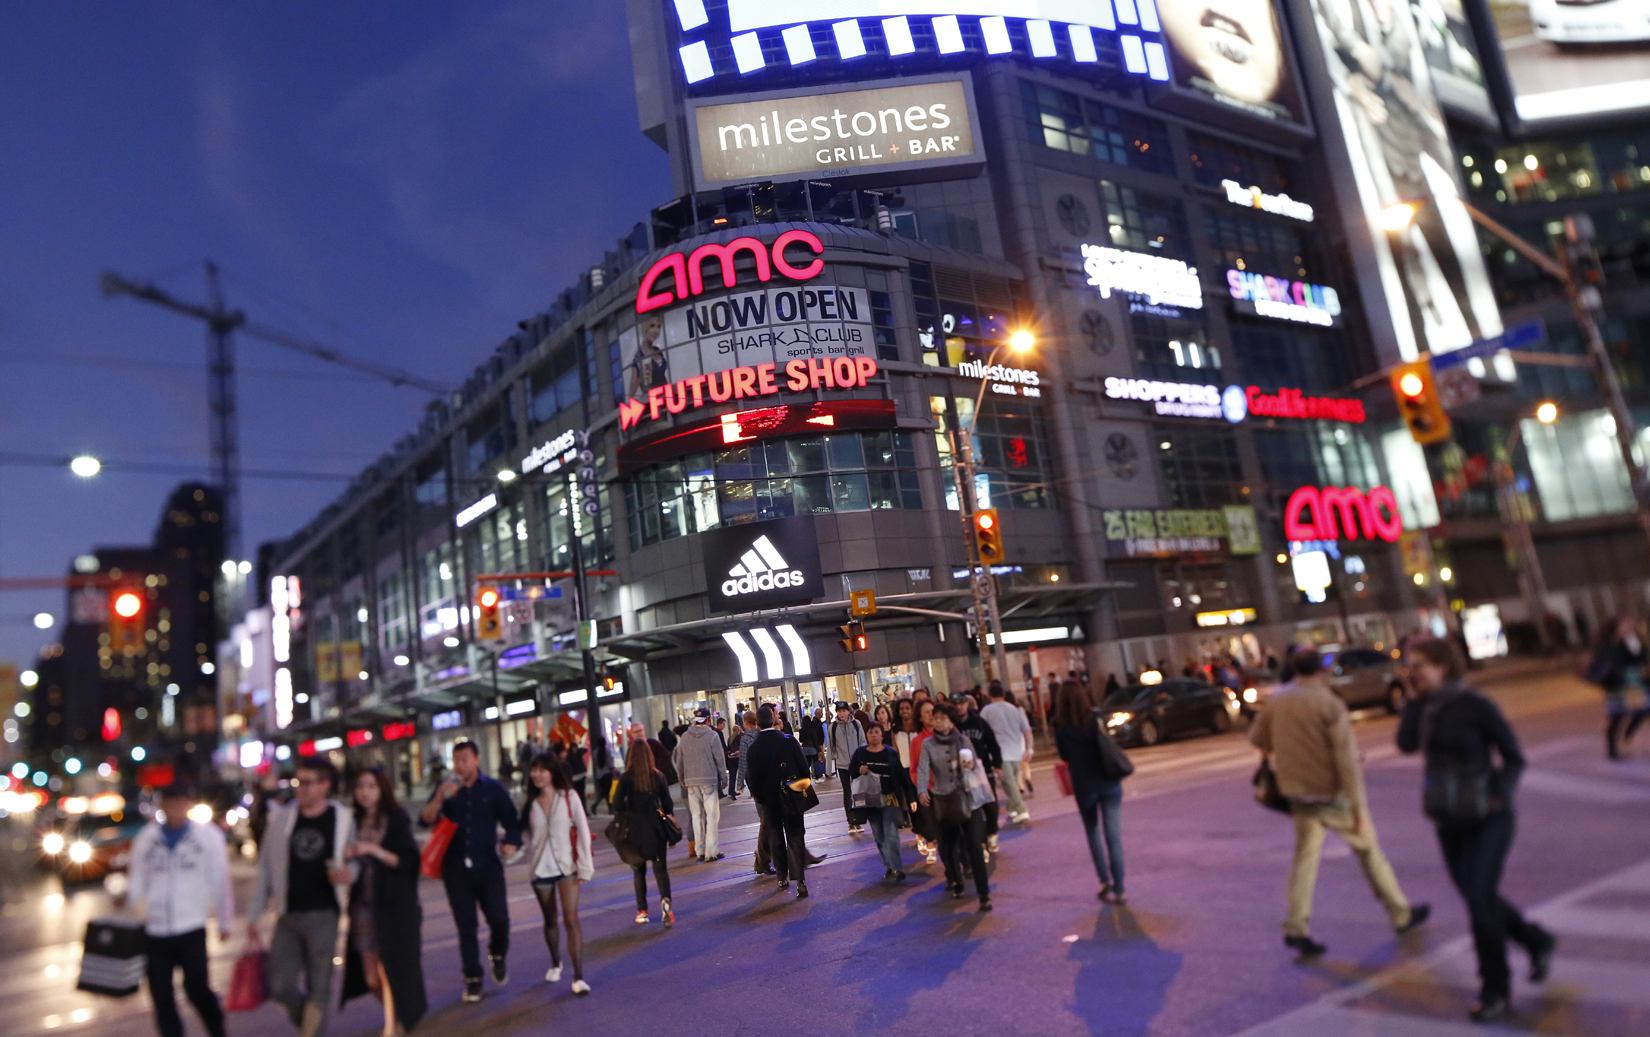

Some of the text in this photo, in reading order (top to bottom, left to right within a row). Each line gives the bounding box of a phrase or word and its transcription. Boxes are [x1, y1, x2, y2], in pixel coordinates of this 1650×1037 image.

[718, 103, 950, 150] milestones
[816, 144, 882, 164] GRILL
[687, 291, 859, 338] NOW OPEN
[717, 328, 862, 354] SHARK CLUB
[787, 345, 865, 357] sports bar grill
[958, 359, 1040, 386] milestones
[648, 356, 877, 420] FUTURE SHOP
[1104, 376, 1222, 405] SHOPPERS
[578, 429, 599, 517] Yonge
[721, 569, 804, 596] adidas
